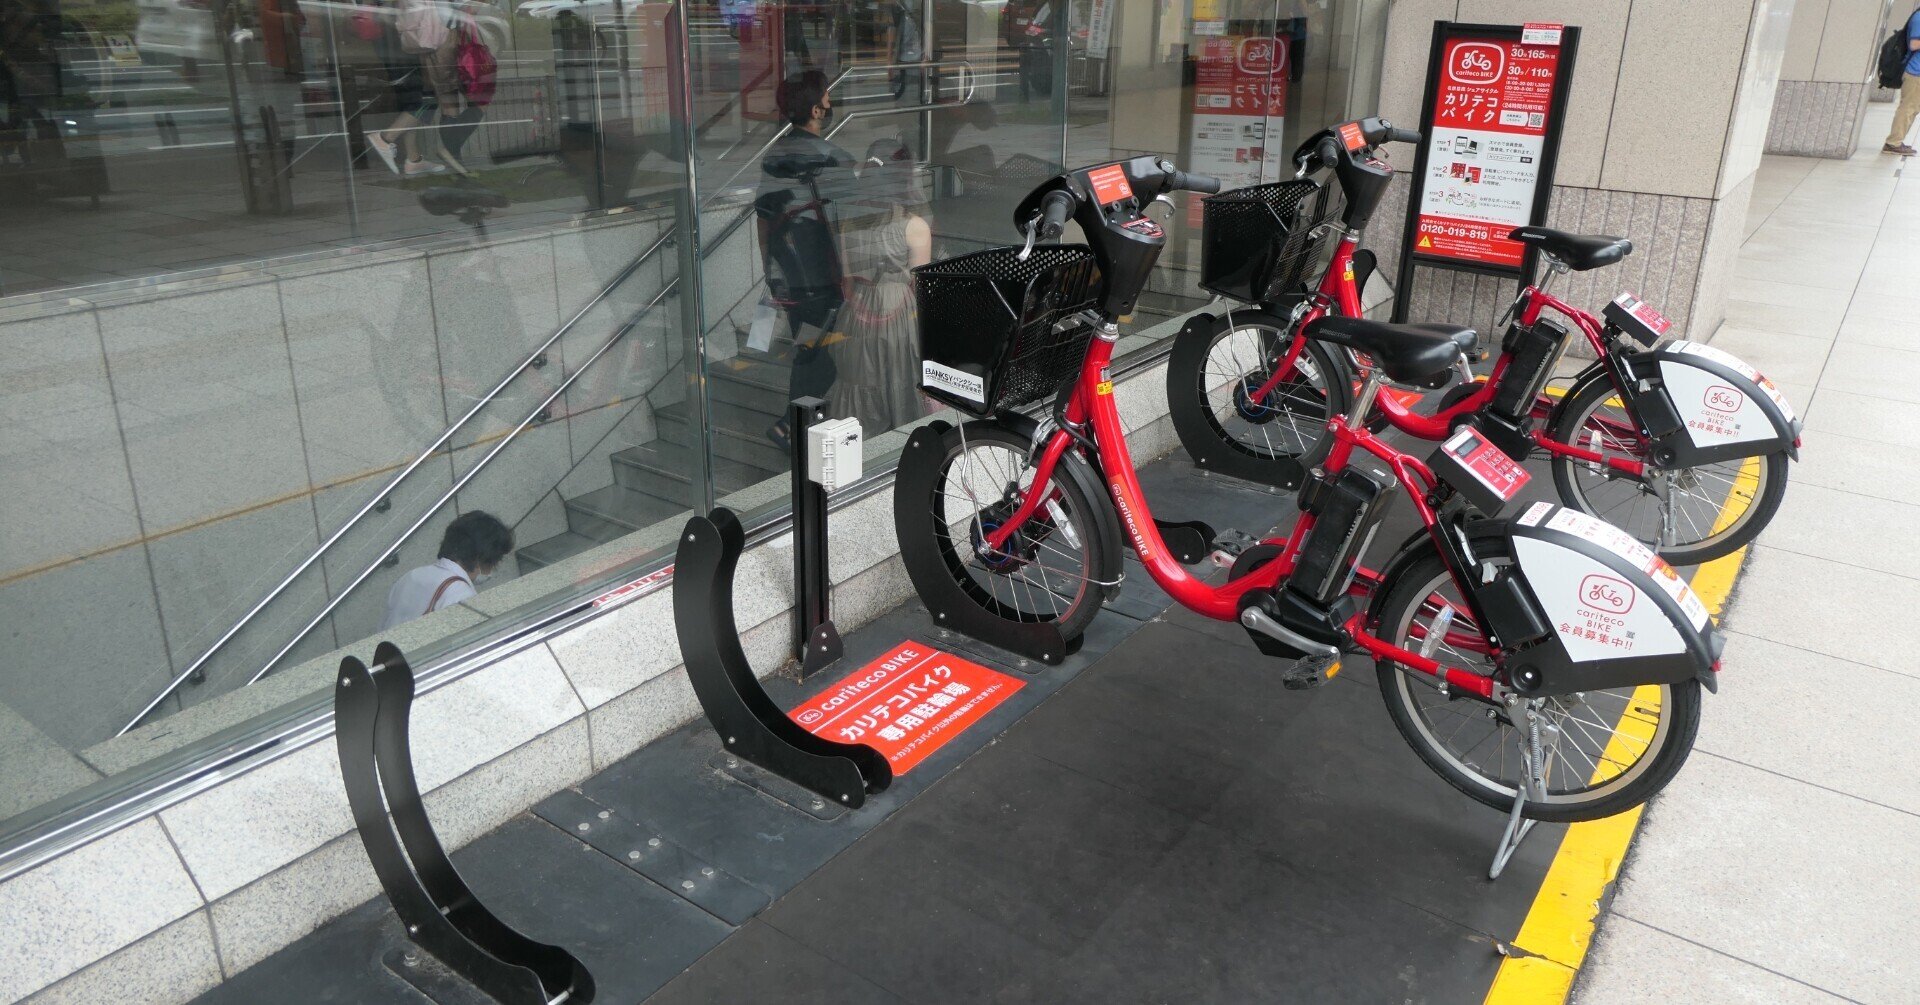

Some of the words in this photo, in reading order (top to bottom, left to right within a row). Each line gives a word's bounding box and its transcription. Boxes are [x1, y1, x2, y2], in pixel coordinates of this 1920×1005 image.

[1445, 92, 1498, 108] カリテコ
[1441, 106, 1495, 123] バイク
[1442, 165, 1448, 173] 2
[1439, 190, 1444, 198] 3
[1420, 223, 1488, 240] 0120-019-819
[925, 368, 954, 382] BANKSY
[1701, 410, 1735, 422] cariteco
[1707, 417, 1726, 426] BIKE
[1117, 496, 1138, 535] cariteco
[1134, 534, 1149, 556] BIKE
[1577, 609, 1625, 627] cariteco
[1586, 619, 1612, 633] BIKE
[1559, 622, 1634, 651] 会員募集中!!
[821, 670, 888, 712] cariteco
[886, 648, 920, 672] BIKE
[840, 664, 953, 742] カリテコバイク
[876, 681, 972, 742] 専用駐輪場
